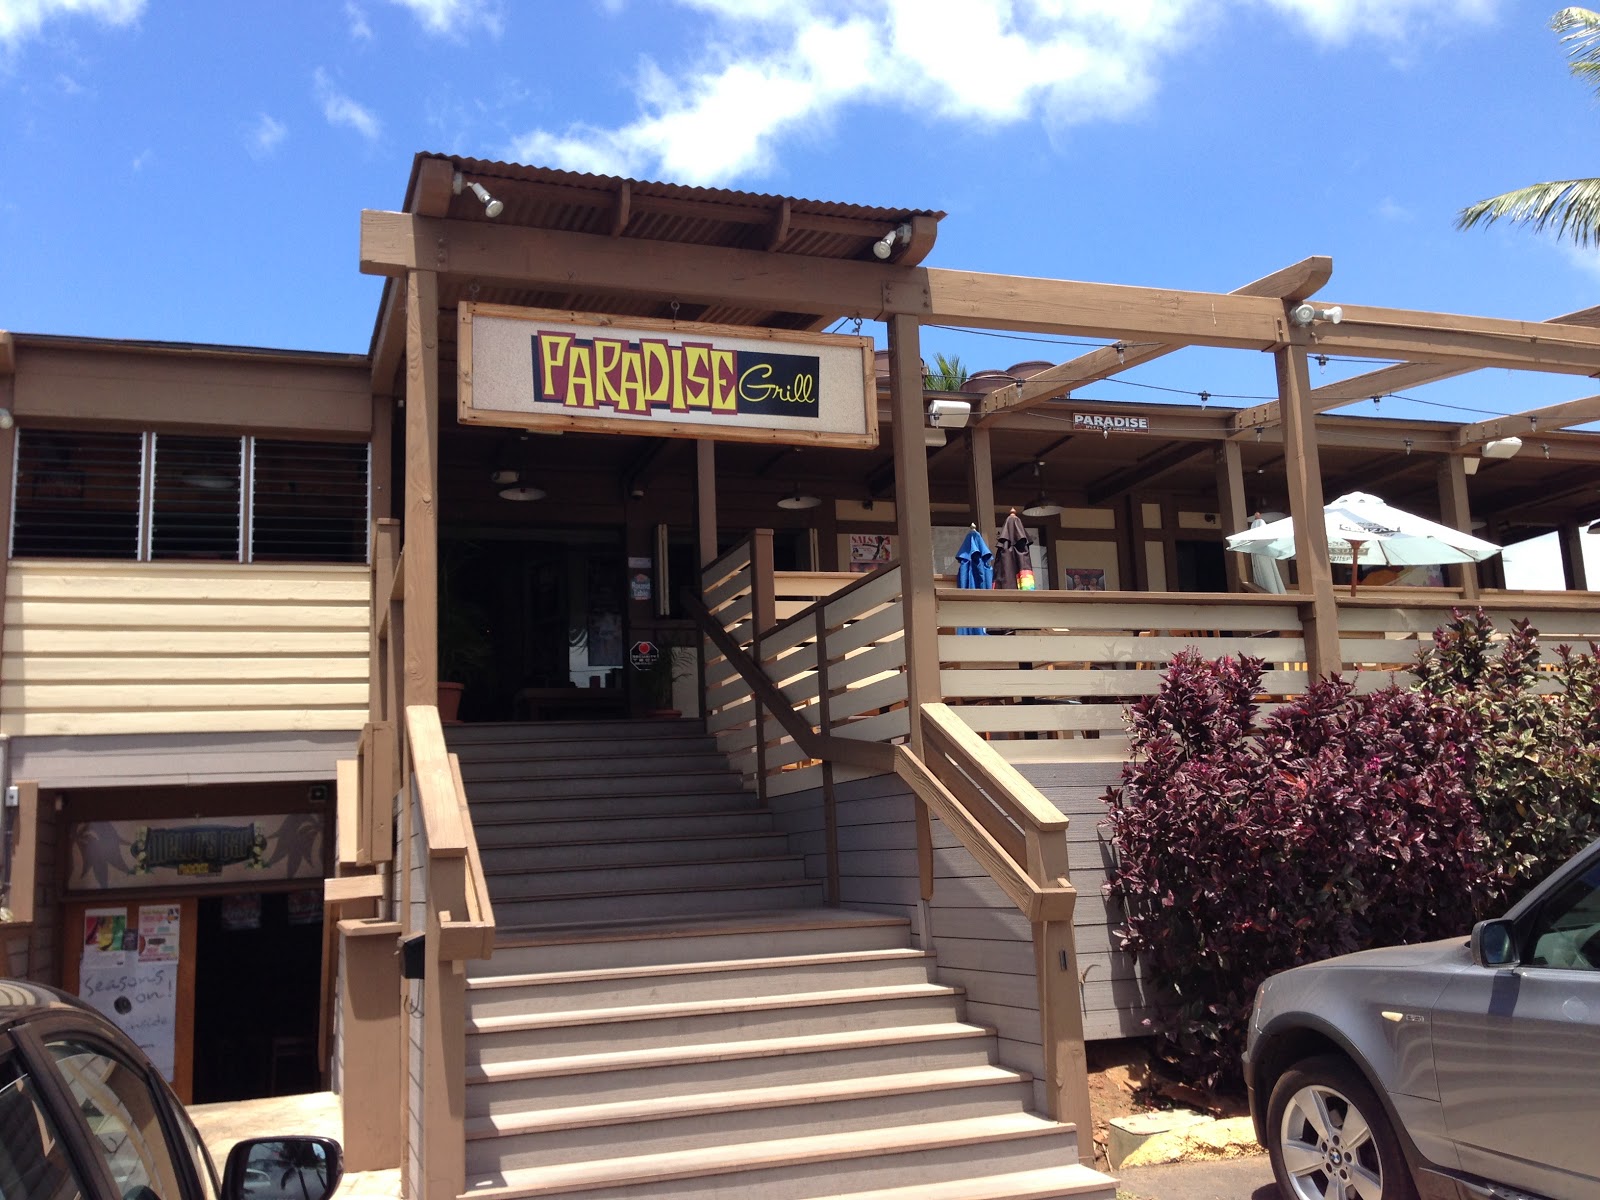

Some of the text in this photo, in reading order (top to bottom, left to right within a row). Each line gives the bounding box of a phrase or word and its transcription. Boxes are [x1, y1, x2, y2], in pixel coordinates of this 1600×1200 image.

[539, 332, 816, 413] PARADISE Grill
[1074, 414, 1148, 429] PARADISE
